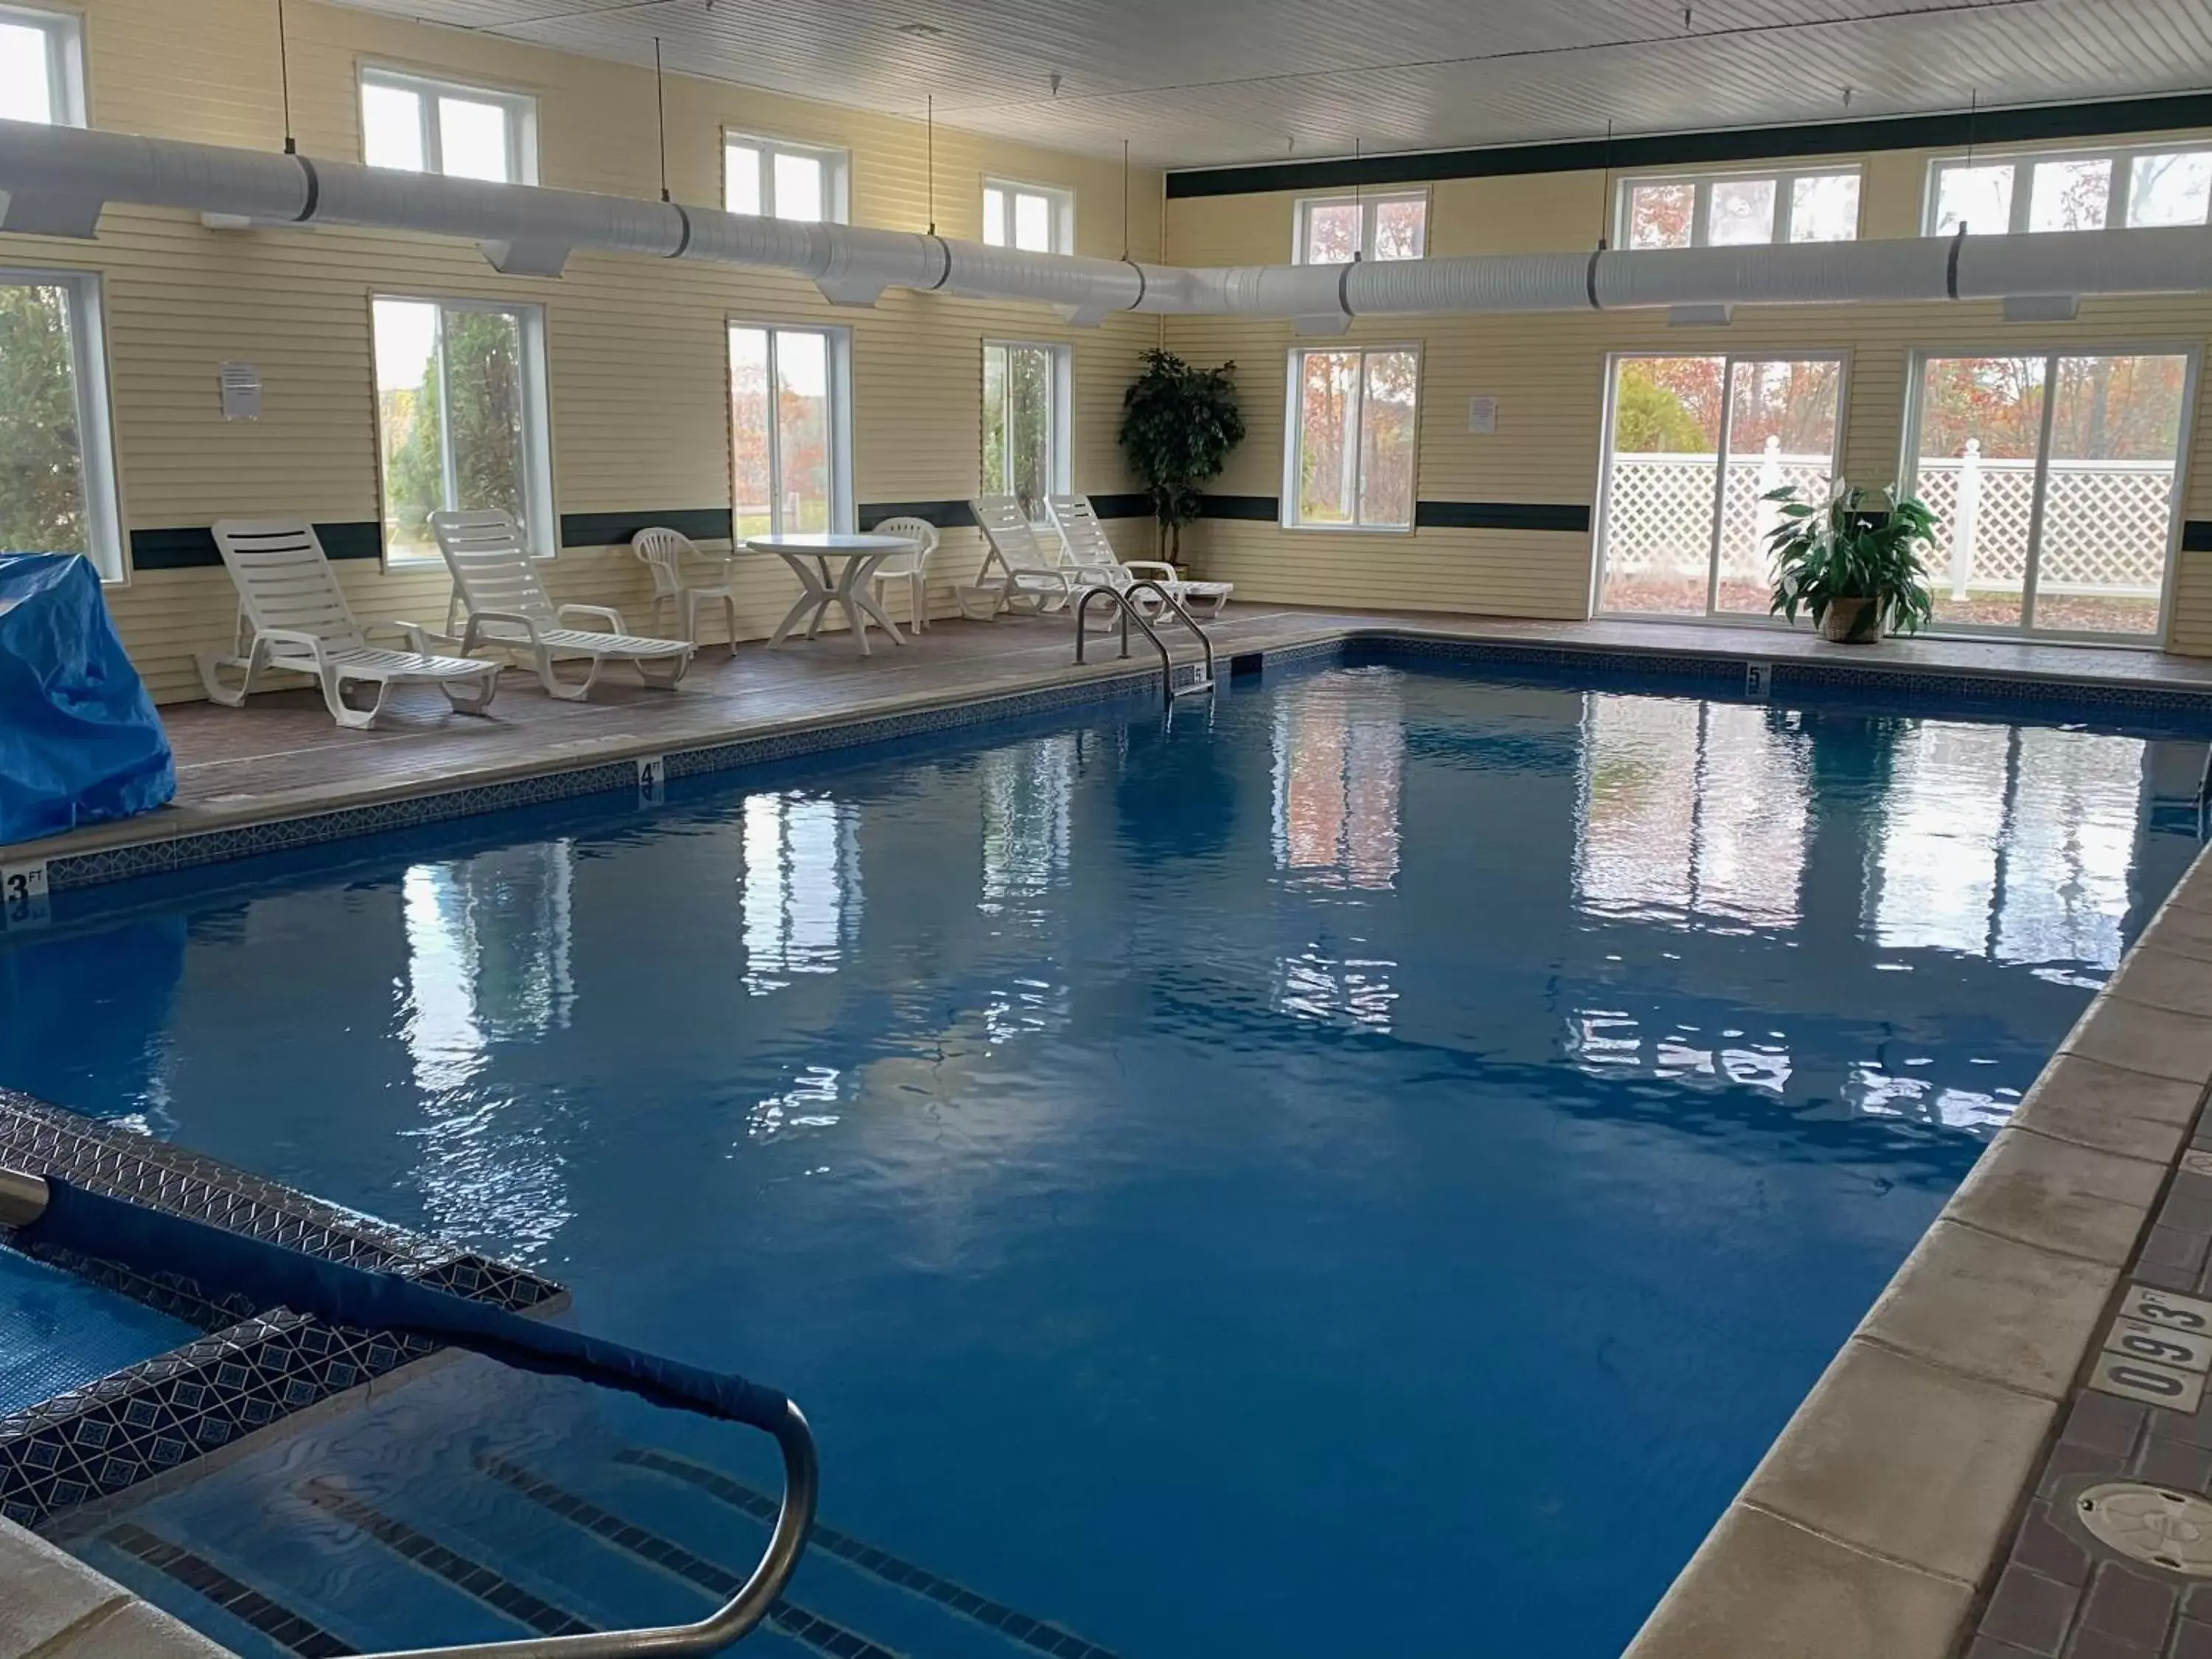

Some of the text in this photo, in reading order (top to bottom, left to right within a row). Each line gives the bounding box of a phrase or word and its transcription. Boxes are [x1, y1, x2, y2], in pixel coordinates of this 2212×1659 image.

[1749, 666, 1760, 683] 5
[641, 762, 654, 784] 4
[7, 870, 42, 902] 3 FT
